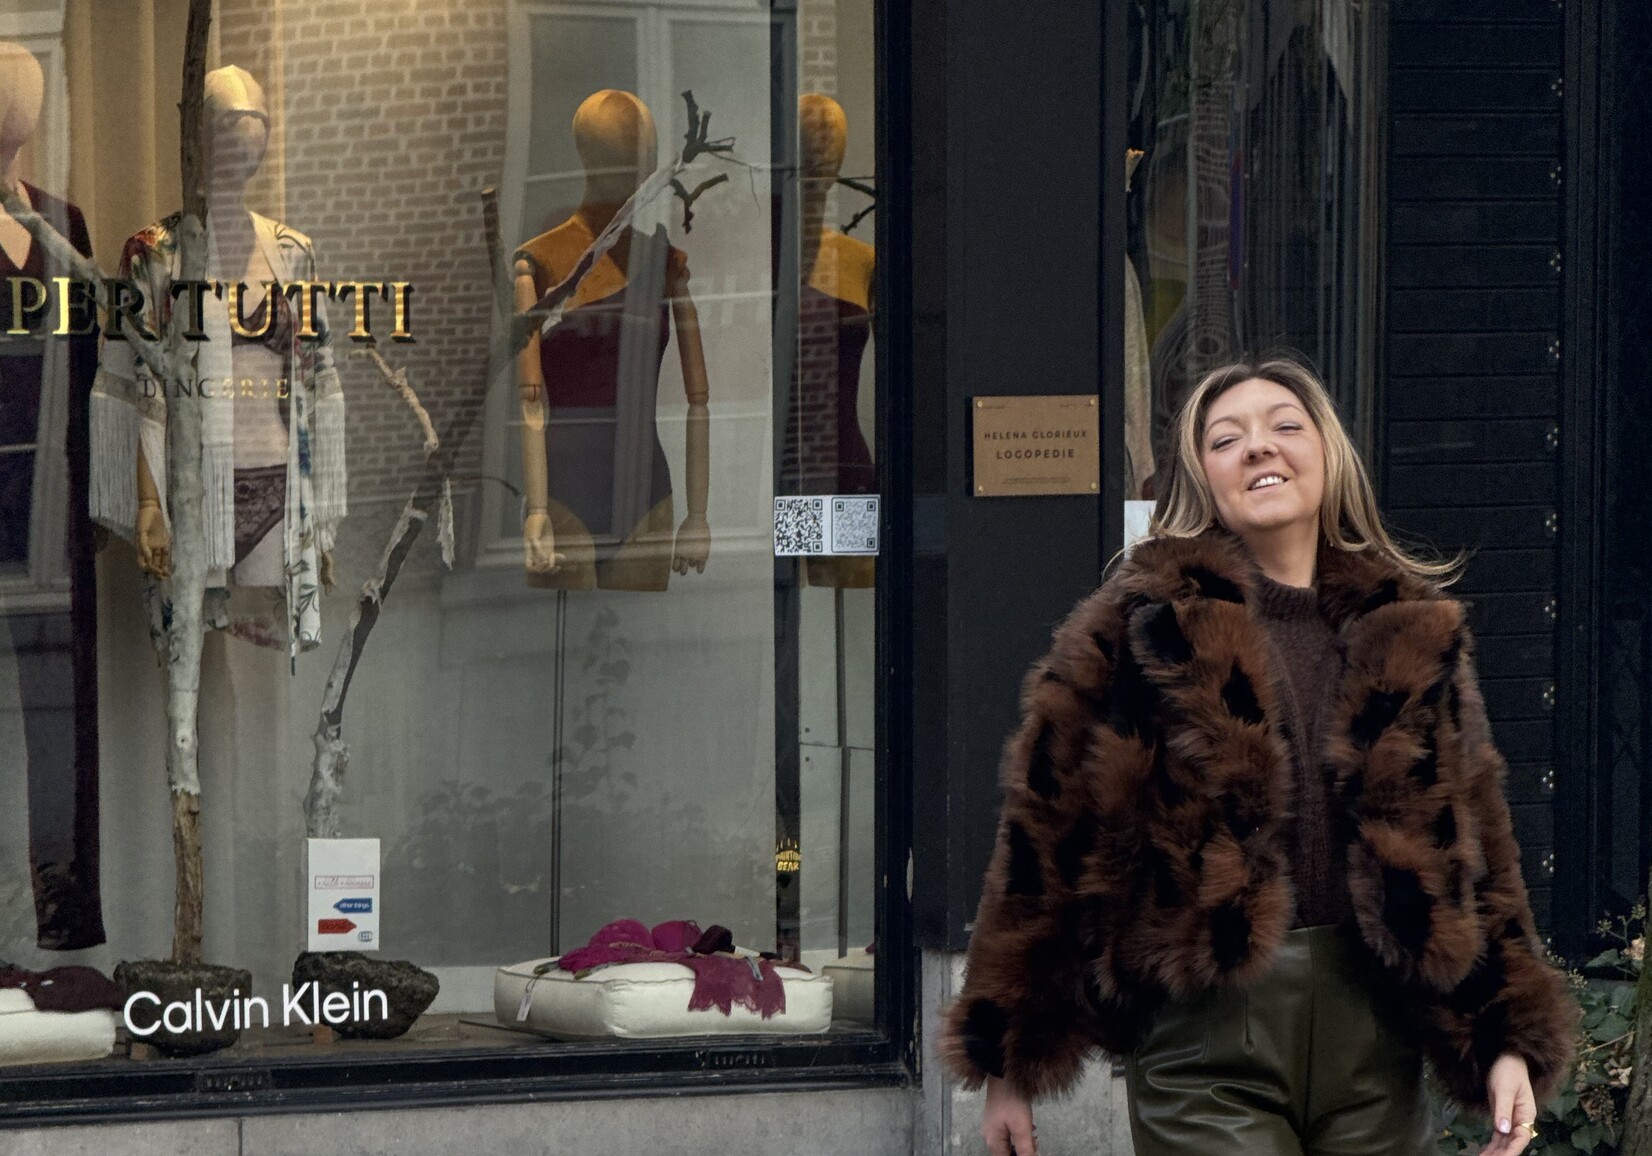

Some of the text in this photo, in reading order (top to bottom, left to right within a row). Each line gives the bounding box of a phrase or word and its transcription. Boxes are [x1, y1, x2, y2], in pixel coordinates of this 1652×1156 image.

[6, 276, 417, 343] PER TUTTI
[984, 430, 1087, 440] HELENA GLORIEUX
[996, 449, 1075, 460] LOGOPEDIE
[123, 980, 389, 1036] Calvin Klein
